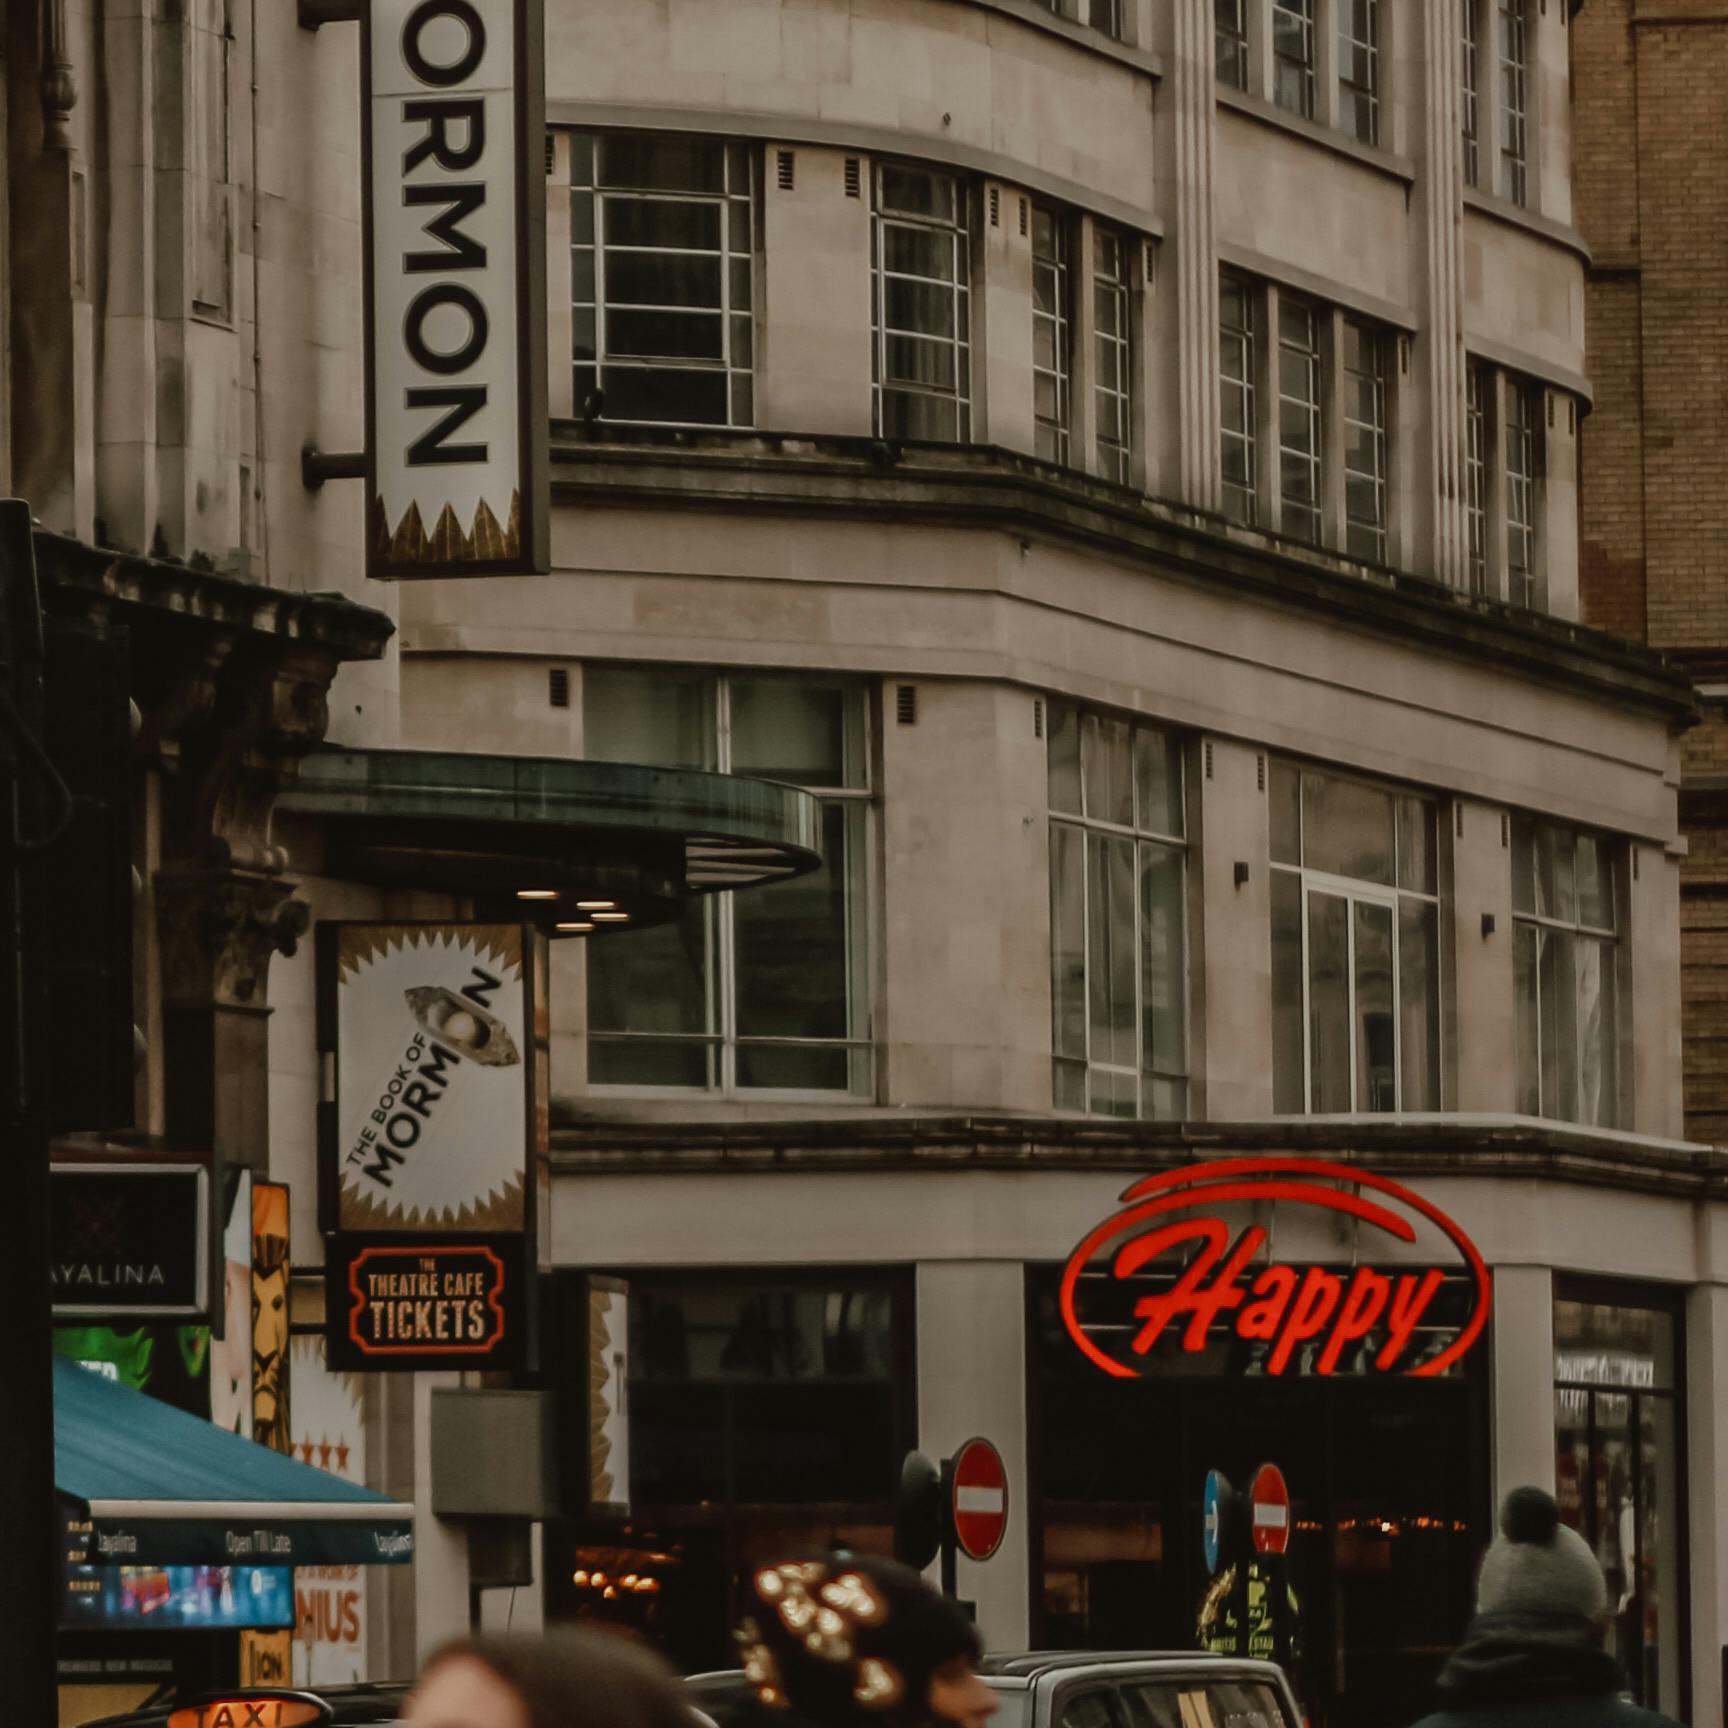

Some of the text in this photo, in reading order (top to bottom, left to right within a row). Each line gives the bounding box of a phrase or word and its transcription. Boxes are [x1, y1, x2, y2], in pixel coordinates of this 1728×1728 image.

[346, 1031, 428, 1166] THE BOOK OF
[368, 1272, 485, 1297] THEATRE CAFE
[1113, 1216, 1445, 1378] Happy
[369, 1299, 486, 1341] TICKETS
[224, 1529, 252, 1556] Open
